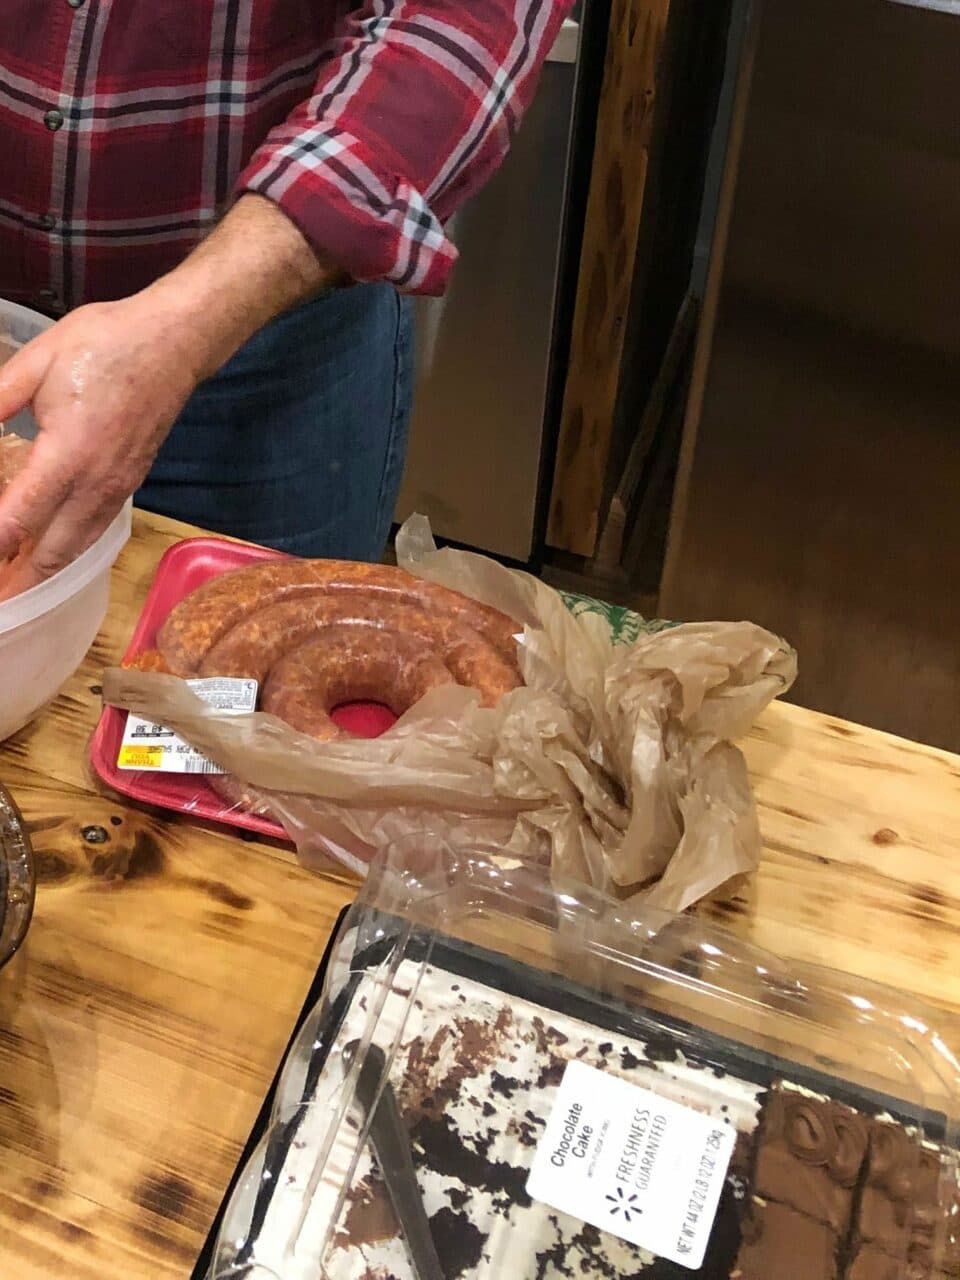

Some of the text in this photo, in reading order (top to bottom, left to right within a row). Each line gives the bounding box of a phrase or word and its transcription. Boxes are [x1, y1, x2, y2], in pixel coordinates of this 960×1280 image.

[550, 1103, 584, 1167] Chocolate
[571, 1125, 594, 1158] Cake
[616, 1107, 650, 1183] FRESHNESS
[635, 1115, 667, 1190] GUARANTEED
[676, 1236, 692, 1255] NET
[681, 1222, 697, 1238] WT
